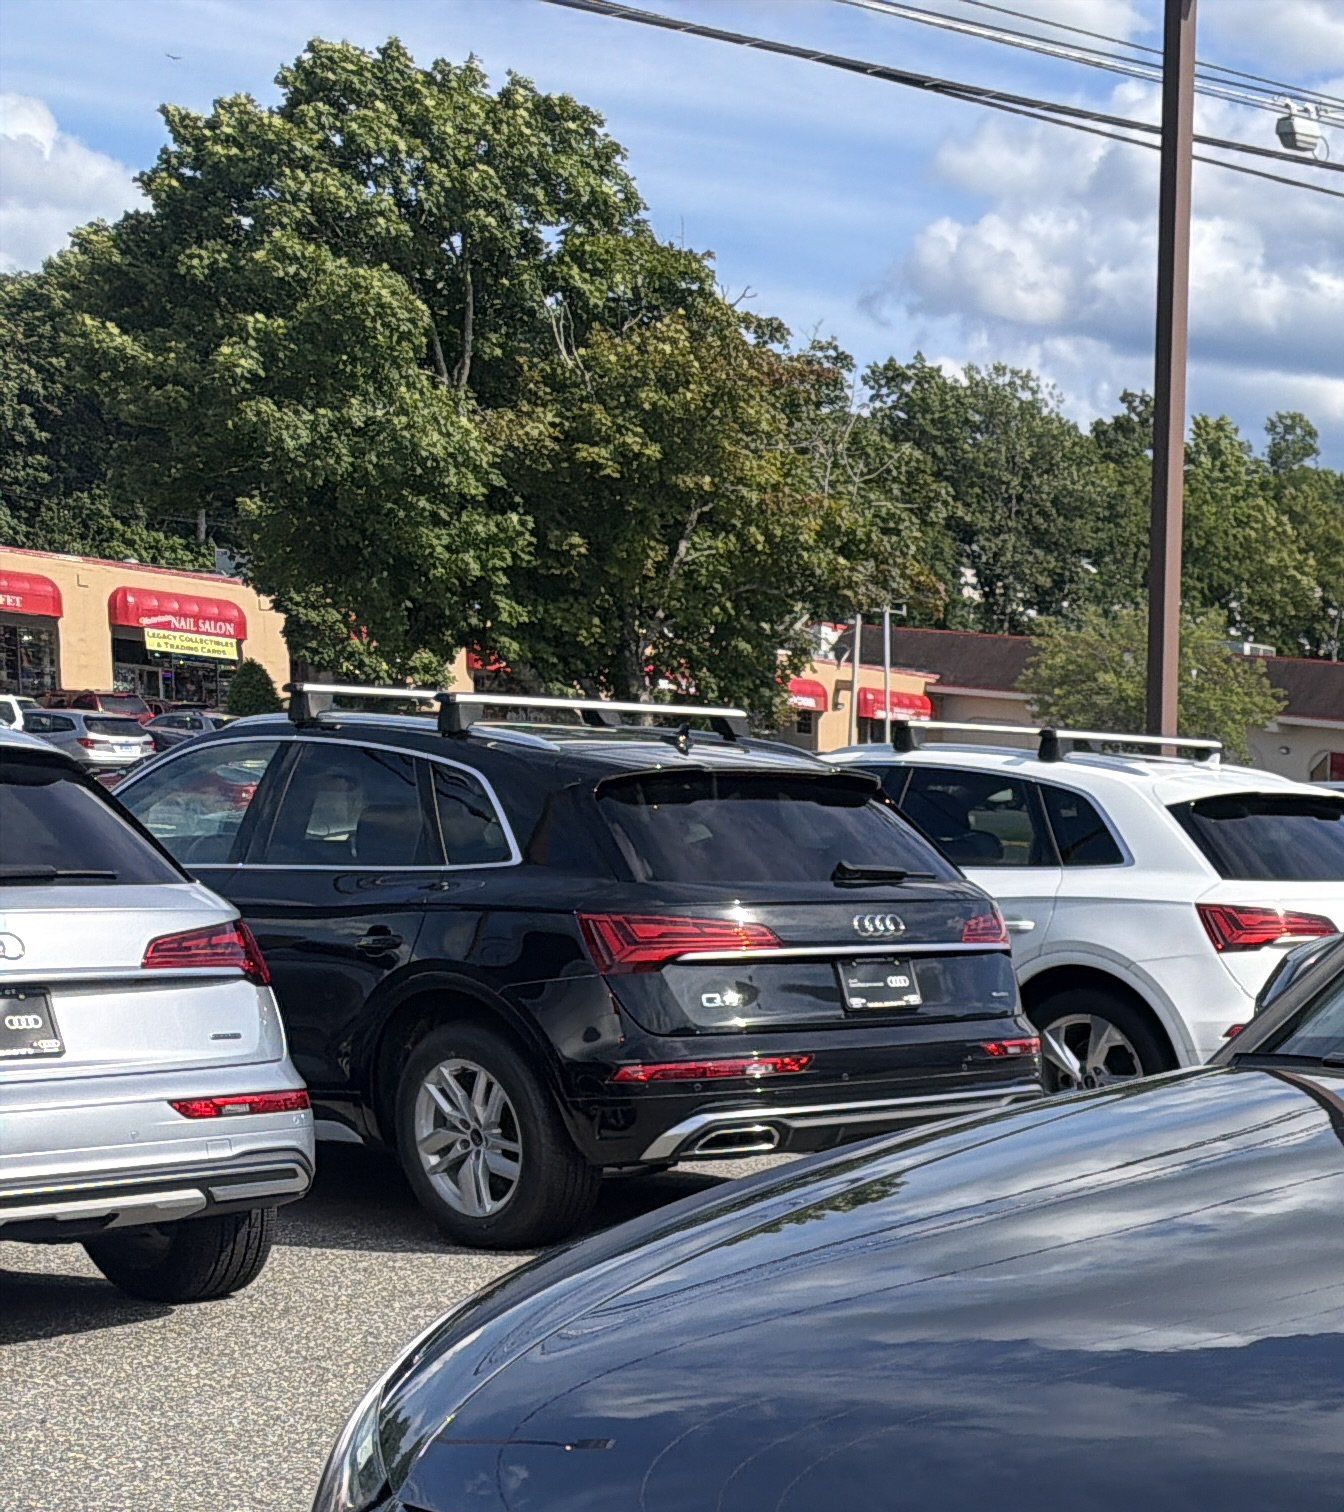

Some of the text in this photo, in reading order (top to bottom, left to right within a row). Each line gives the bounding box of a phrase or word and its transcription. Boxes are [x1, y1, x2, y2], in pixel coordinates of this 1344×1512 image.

[171, 616, 197, 631] NAIL
[199, 619, 235, 635] SALON
[147, 631, 234, 648] LEGACY COLLECTIBLES
[164, 641, 199, 652] TRADING
[201, 646, 227, 656] CARDS
